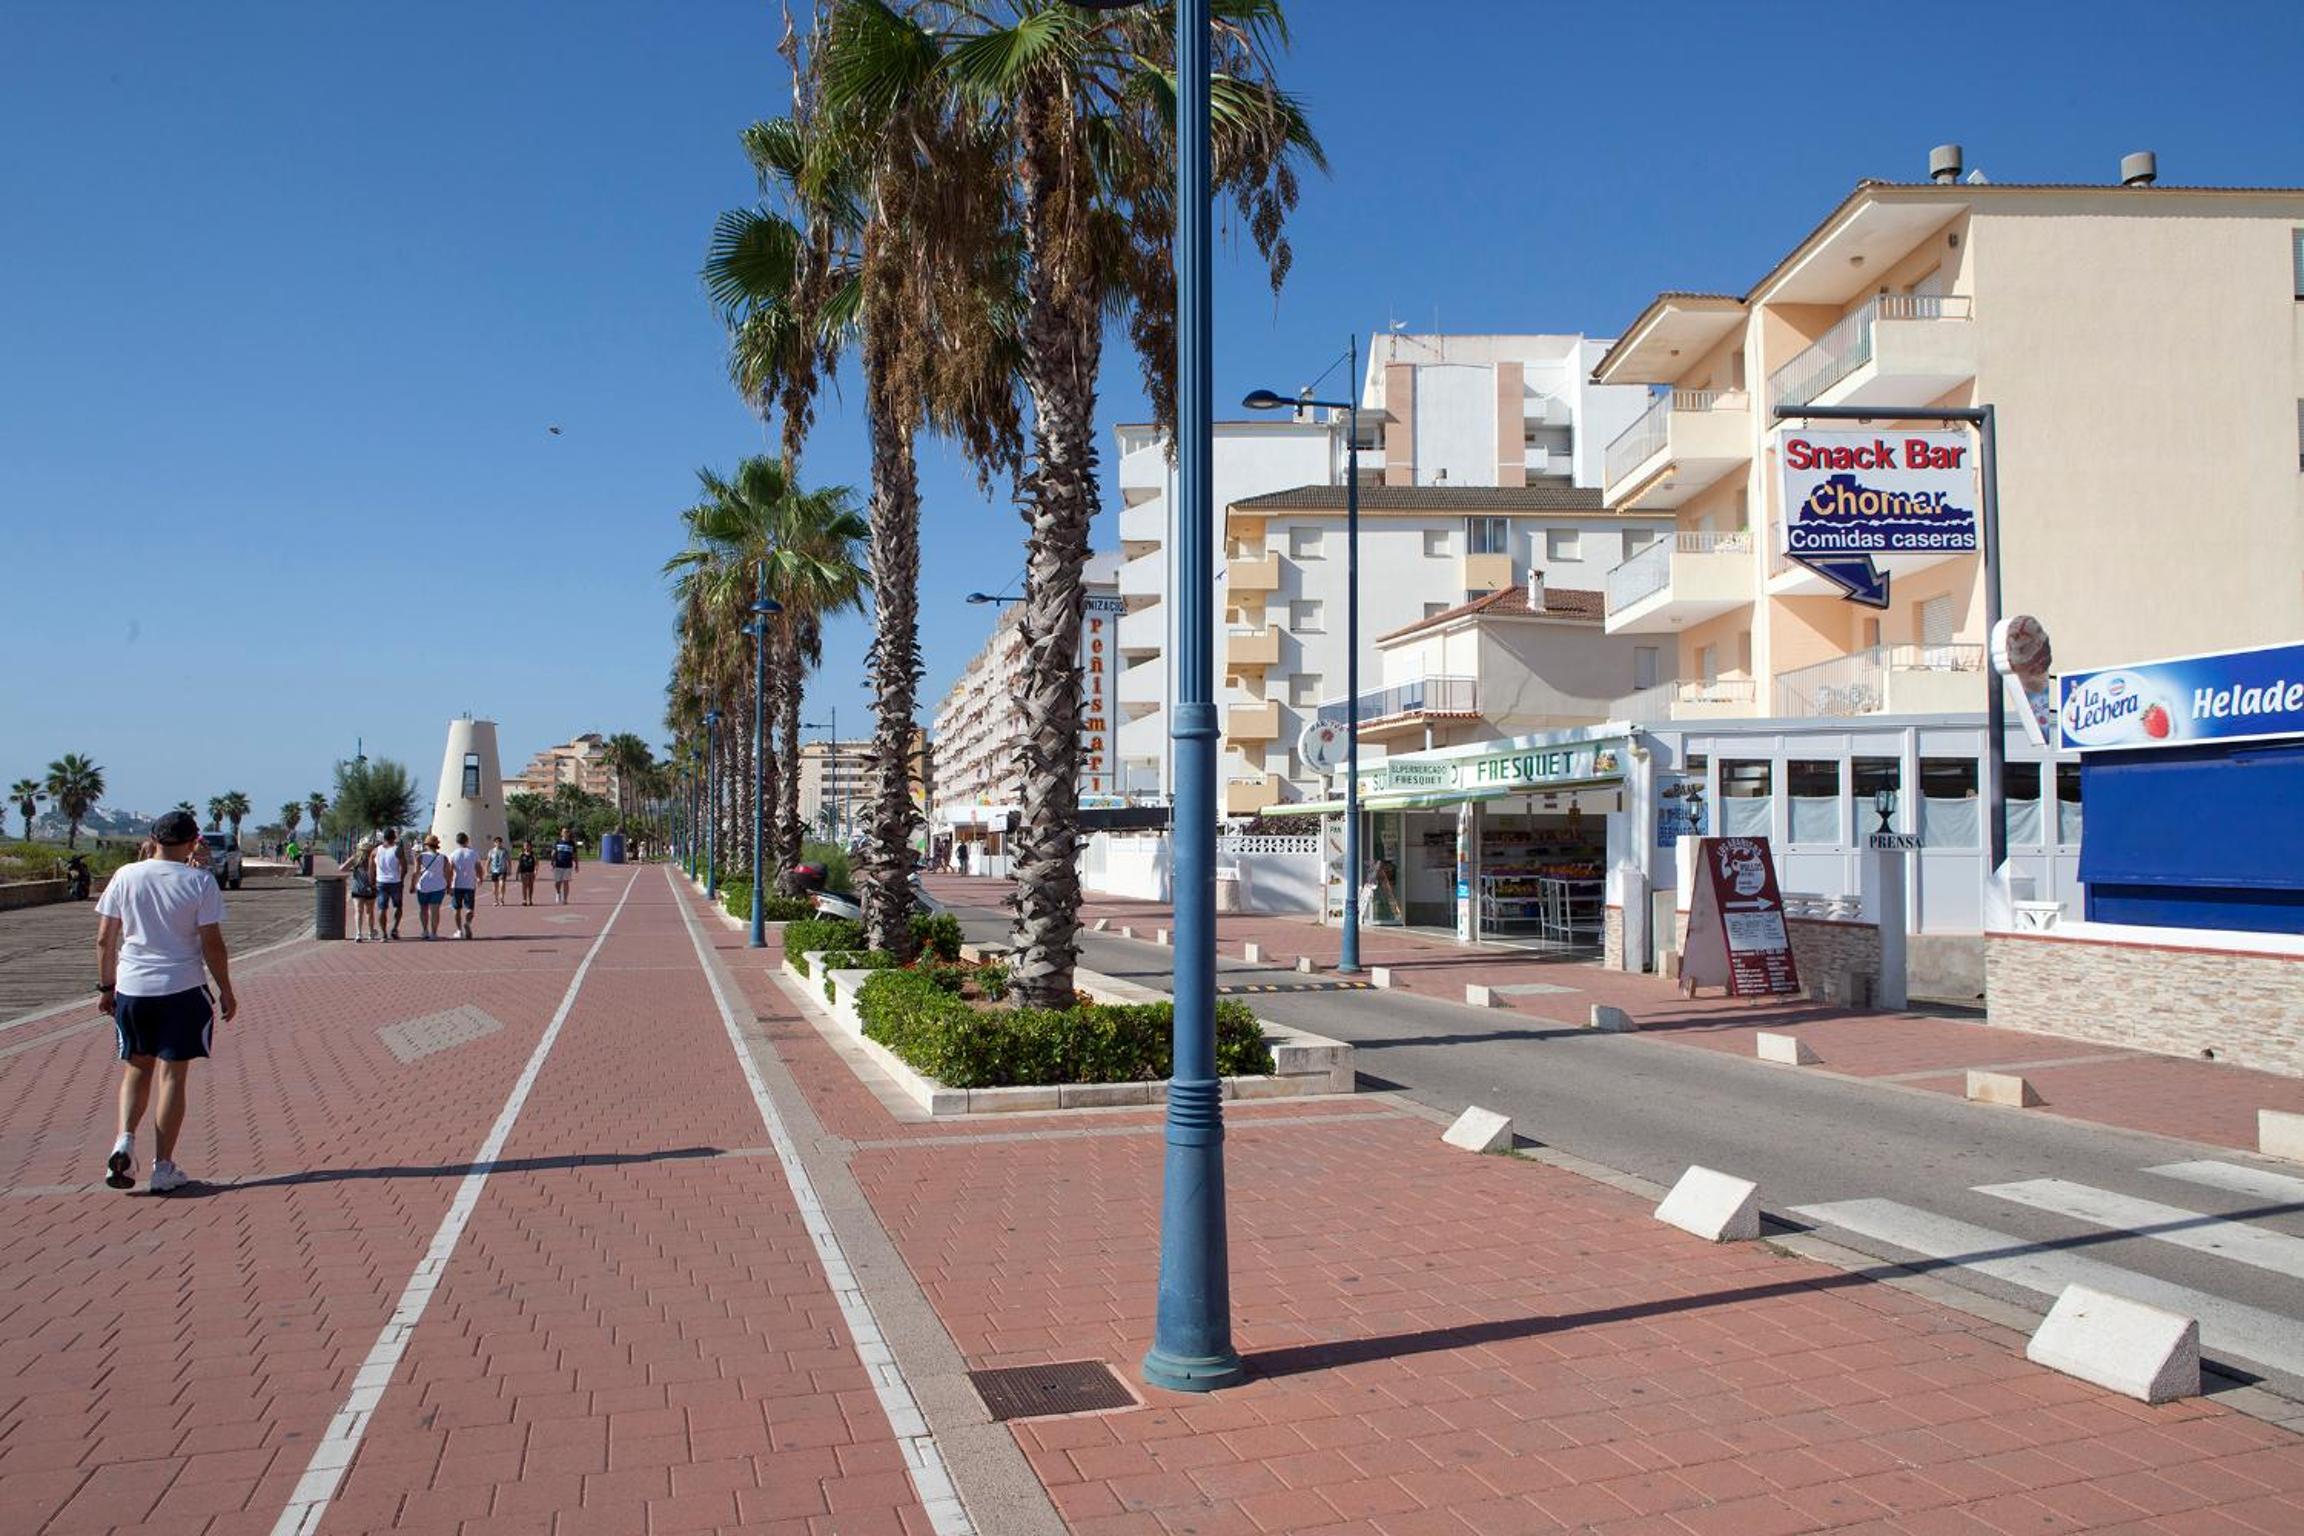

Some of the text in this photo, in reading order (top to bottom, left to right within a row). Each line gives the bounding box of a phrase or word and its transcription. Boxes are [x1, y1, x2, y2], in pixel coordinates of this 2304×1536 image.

[1787, 438, 1967, 470] Snack Bar
[1810, 482, 1947, 516] Chomar
[1790, 529, 1976, 549] Comidas caseras
[2084, 689, 2099, 707] La
[2192, 680, 2304, 720] Helade
[2074, 694, 2138, 731] Lechera
[1391, 764, 1448, 774] SUPERMERCADO
[1477, 751, 1574, 782] FRESQUET
[1395, 775, 1442, 785] FRESQUET
[1869, 835, 1923, 849] PRENSA
